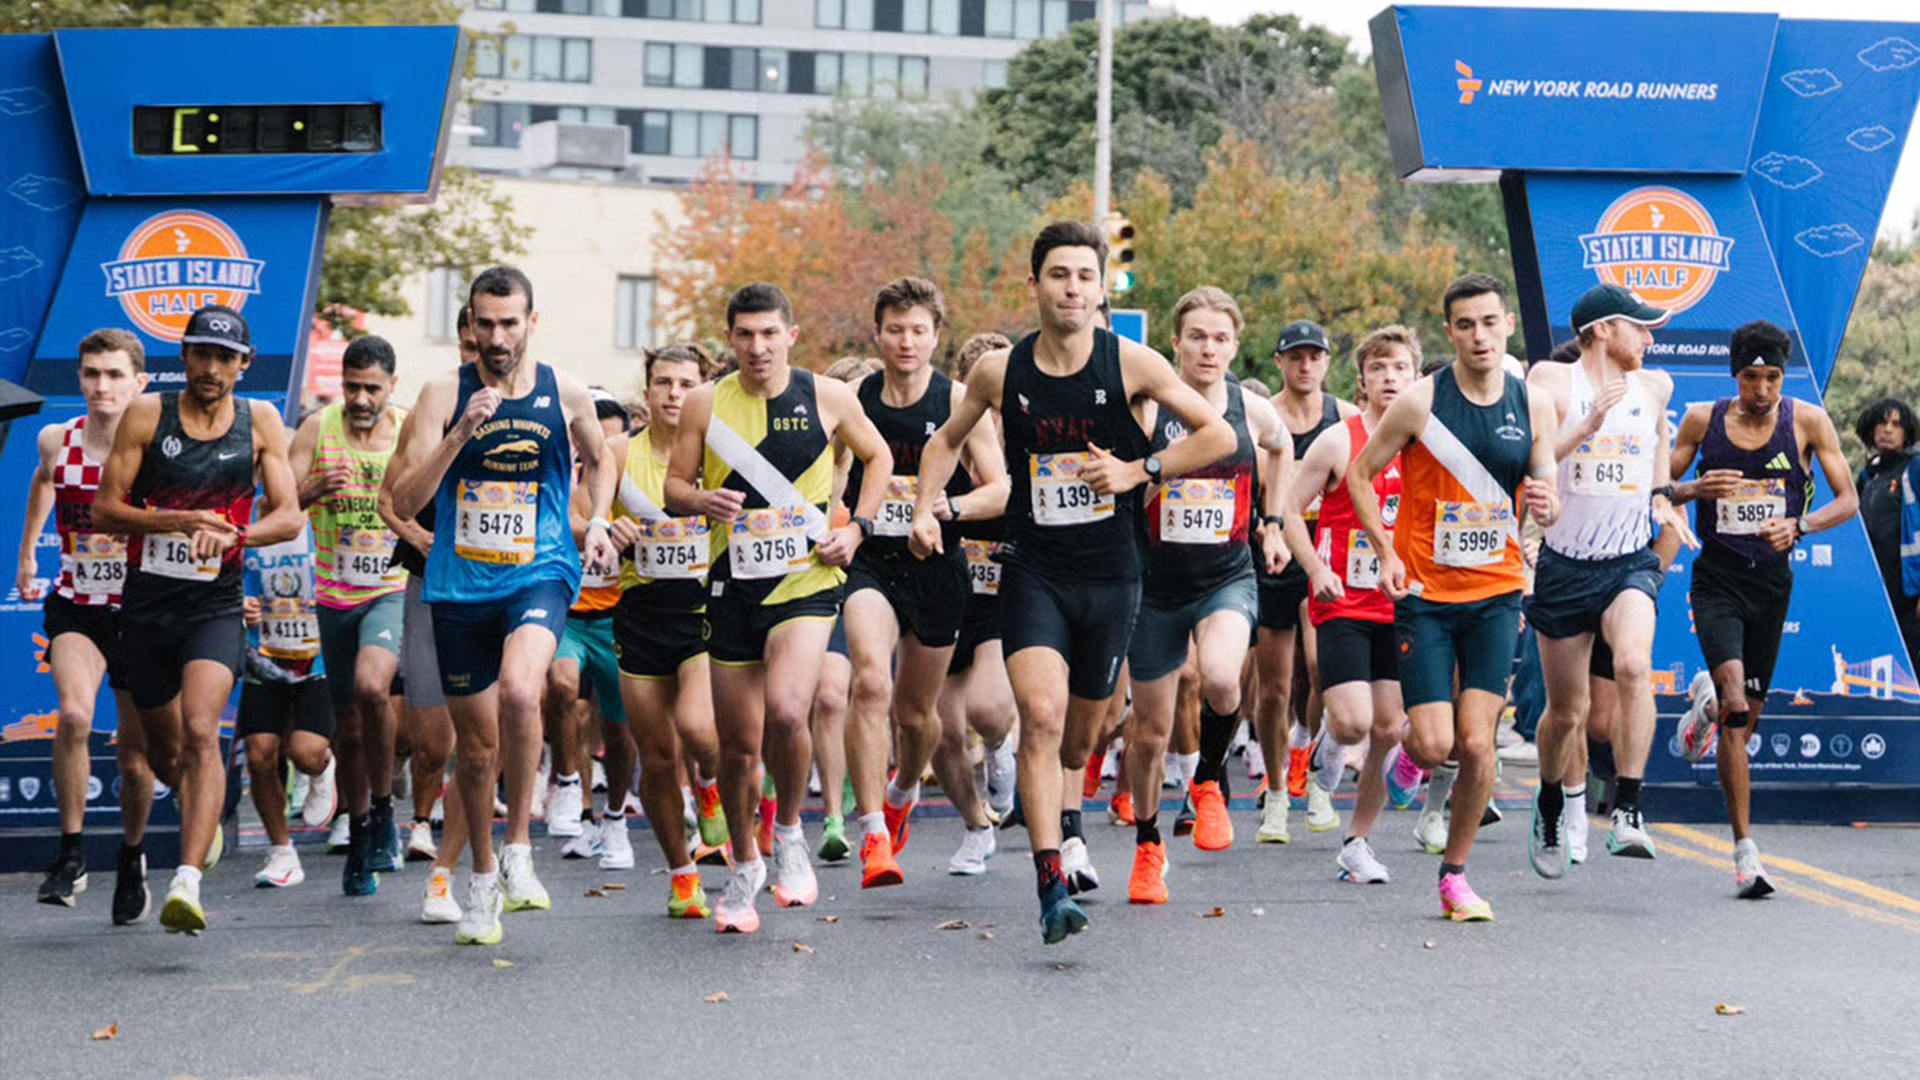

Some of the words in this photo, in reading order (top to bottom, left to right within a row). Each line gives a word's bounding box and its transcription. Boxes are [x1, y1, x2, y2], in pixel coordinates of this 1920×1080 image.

[1488, 79, 1529, 97] NEW
[1533, 80, 1582, 98] YORK
[1584, 81, 1634, 99] ROAD
[1636, 83, 1718, 100] RUNNERS
[1589, 235, 1653, 263] STATEN
[1661, 235, 1725, 264] ISLAND
[111, 261, 180, 290] STATEN
[187, 260, 255, 288] ISLAND
[1625, 267, 1689, 289] HALF
[1677, 344, 1707, 356] ROAD
[773, 417, 809, 431] GSTC
[1595, 463, 1624, 482] 643
[1183, 509, 1223, 528] 5479
[1737, 504, 1775, 522] 5897
[479, 513, 523, 535] 5478
[753, 538, 796, 563] 3756
[1459, 531, 1498, 552] 5996
[656, 545, 697, 565] 3754
[92, 562, 128, 580] 238
[352, 556, 390, 574] 4616
[275, 622, 309, 638] 4111
